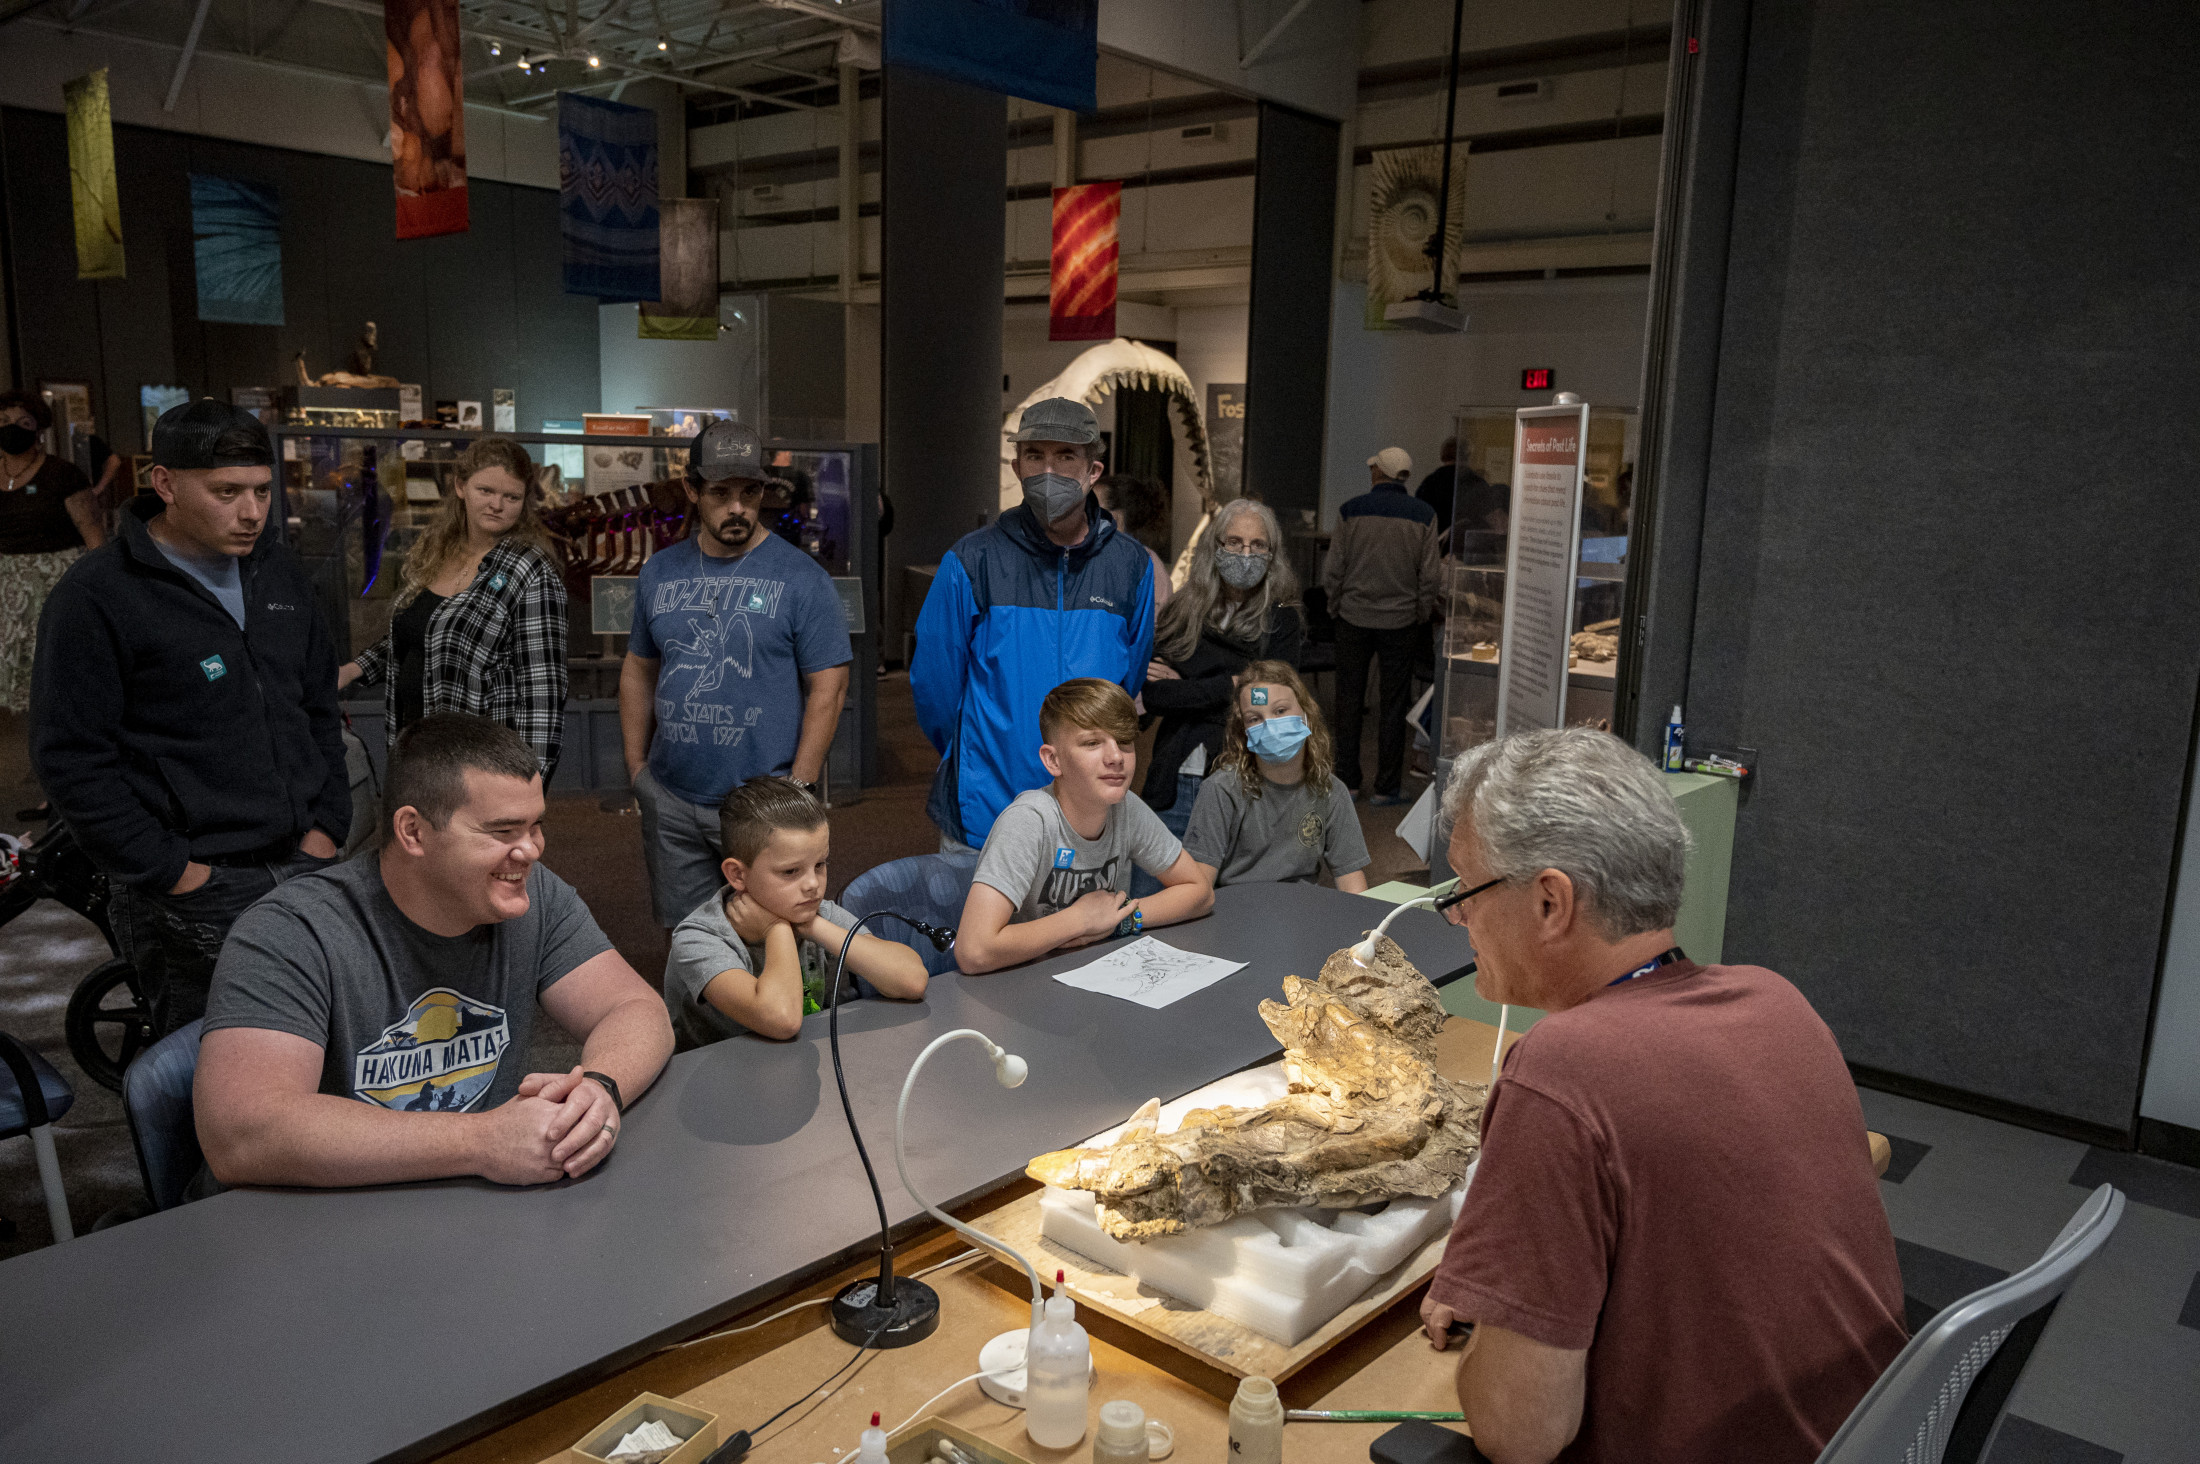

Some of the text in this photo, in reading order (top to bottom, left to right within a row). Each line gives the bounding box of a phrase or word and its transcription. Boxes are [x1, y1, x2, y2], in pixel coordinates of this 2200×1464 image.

[1526, 369, 1549, 389] EXIT
[1217, 393, 1246, 419] Fos
[1526, 436, 1576, 453] Secrets of Past Life
[682, 702, 735, 725] STATES
[743, 706, 763, 726] OF
[713, 726, 746, 747] 1977
[361, 1048, 433, 1085] HAKUNA
